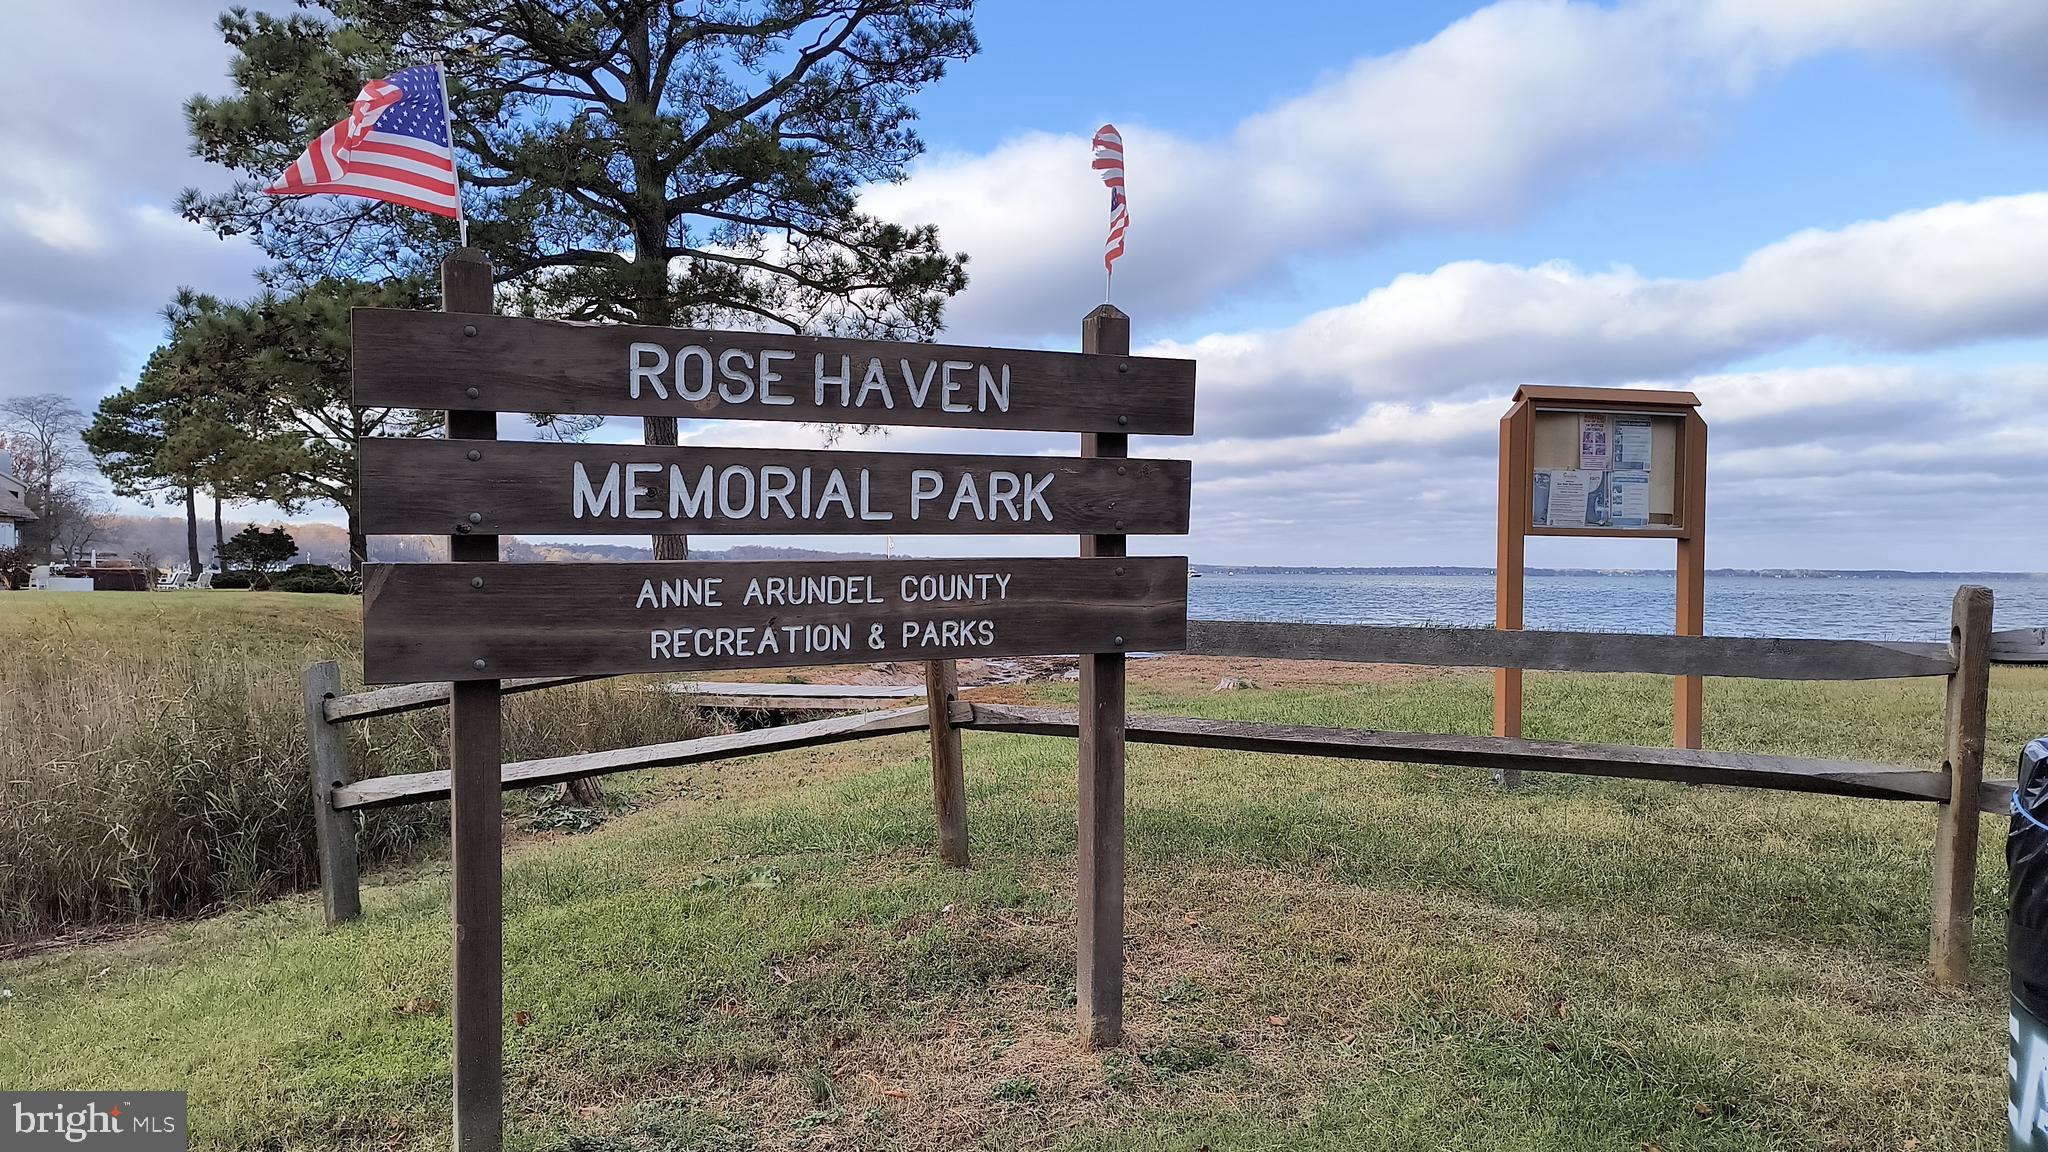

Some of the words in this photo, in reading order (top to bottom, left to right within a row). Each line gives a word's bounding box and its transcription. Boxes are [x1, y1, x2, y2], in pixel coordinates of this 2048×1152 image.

[629, 342, 797, 406] ROSE
[814, 352, 1010, 413] HAVEN
[573, 461, 892, 520] MEMORIAL
[911, 469, 1055, 522] PARK
[636, 578, 723, 609] ANNE
[743, 575, 884, 607] ARUNDEL
[902, 573, 1012, 604] COUNTY
[650, 624, 851, 659] RECREATION
[869, 624, 886, 650] &
[903, 619, 995, 647] PARKS
